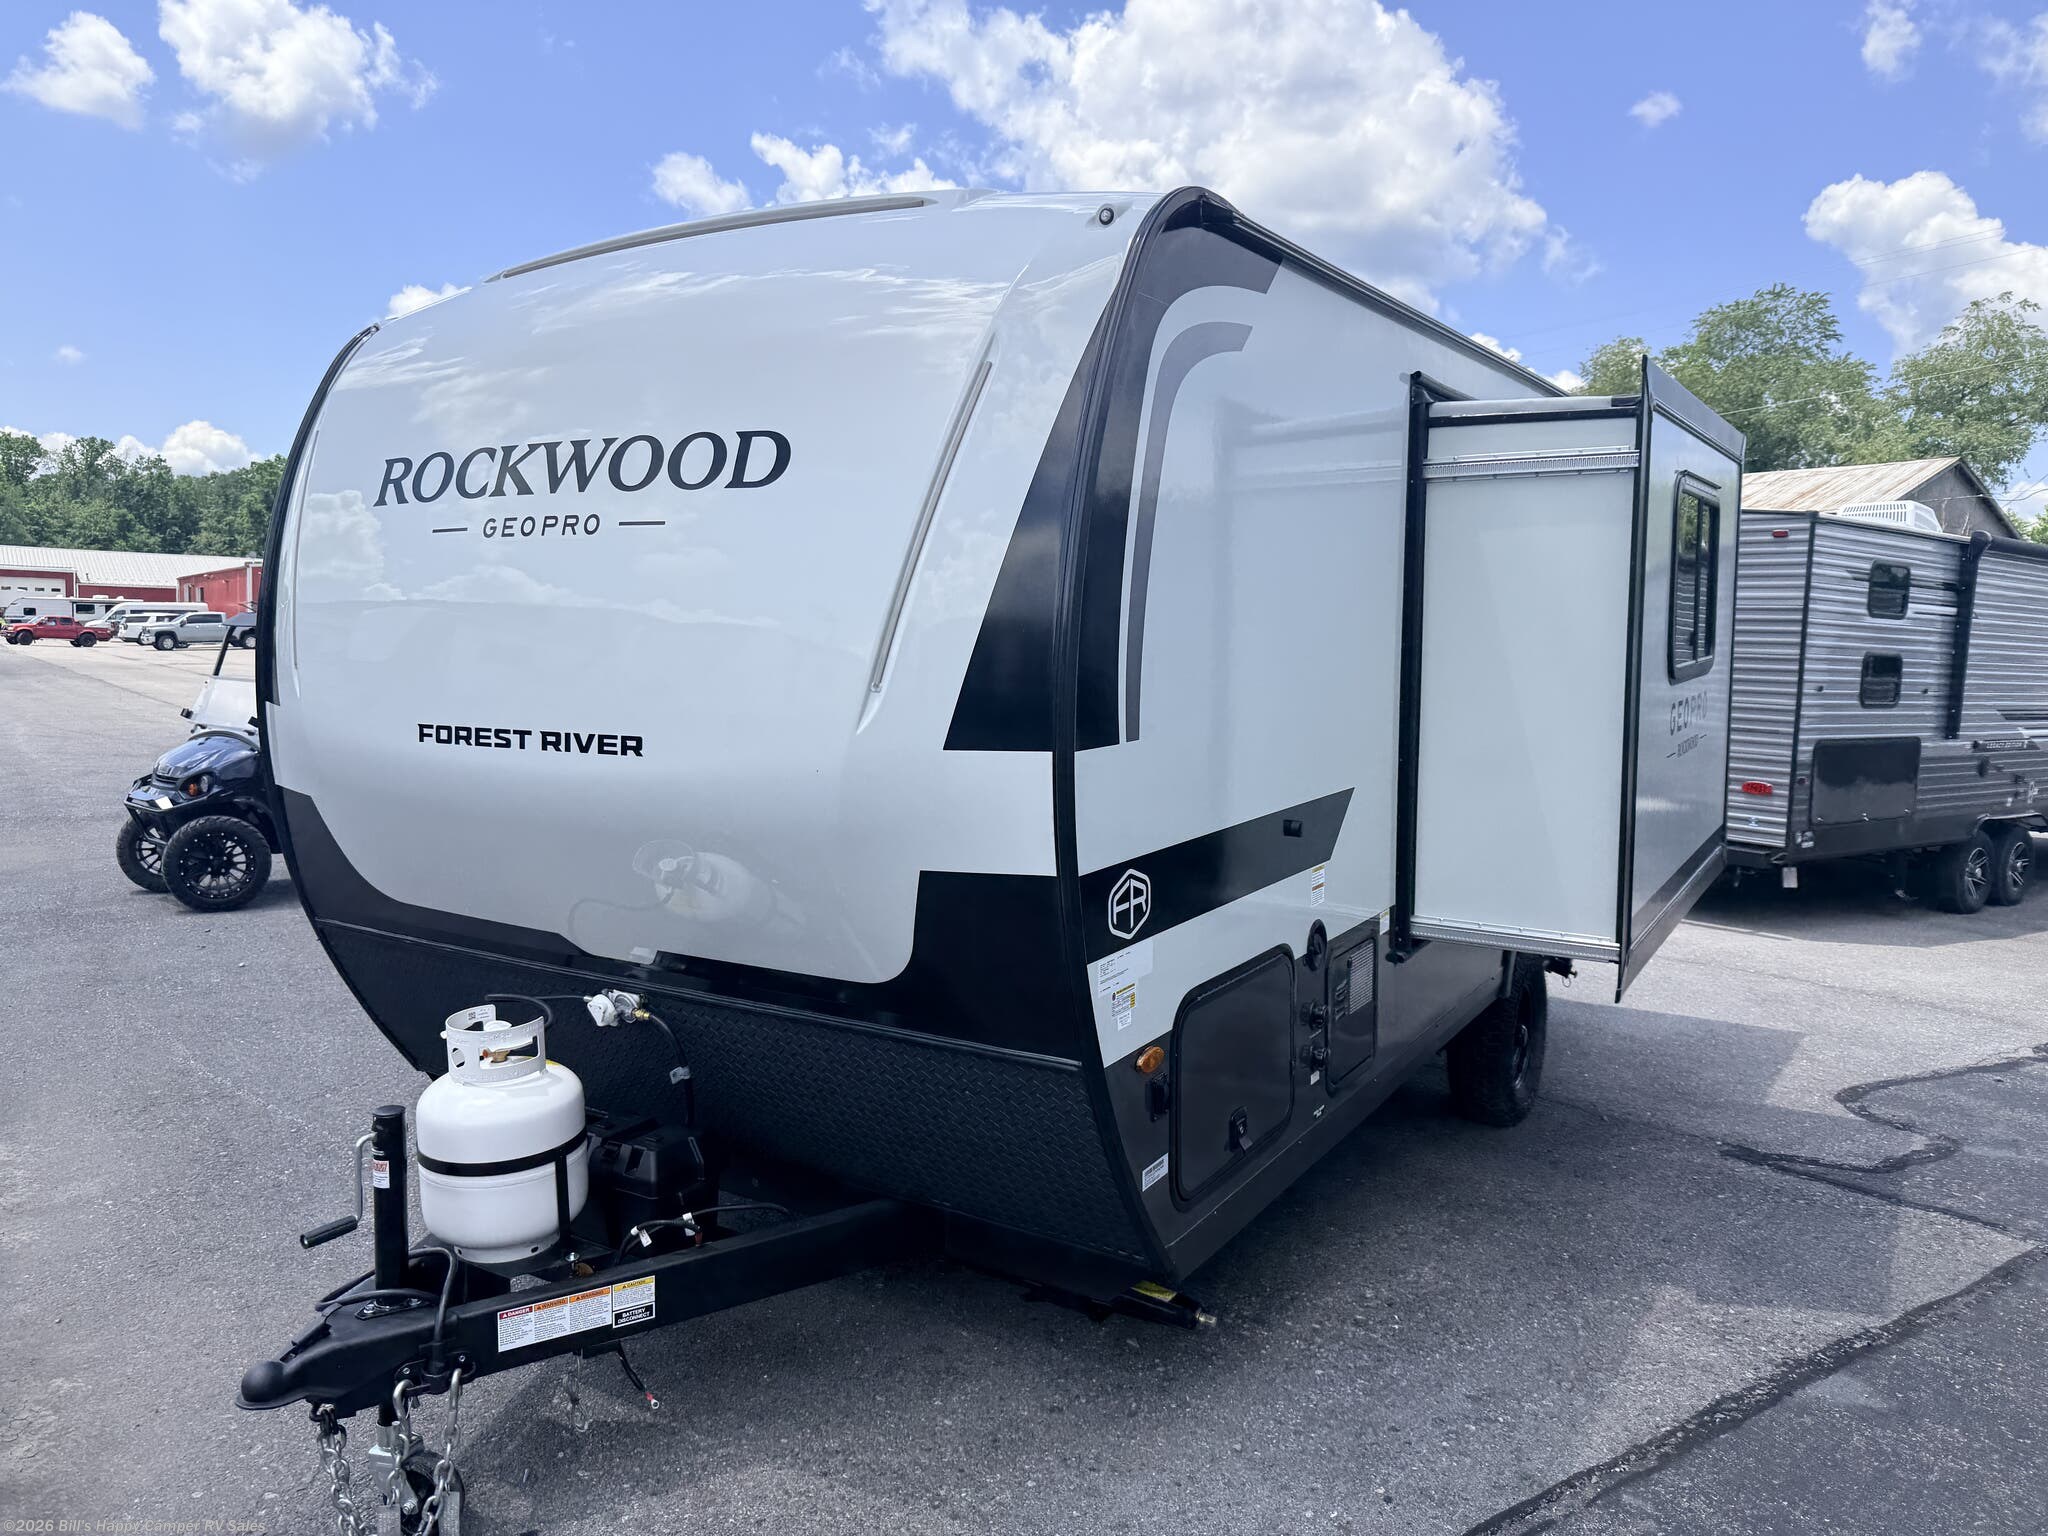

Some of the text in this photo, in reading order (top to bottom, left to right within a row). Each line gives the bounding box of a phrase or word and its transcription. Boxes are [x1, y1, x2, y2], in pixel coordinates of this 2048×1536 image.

[373, 430, 792, 507] ROCKWOOD
[482, 513, 601, 539] GEOPRO
[417, 723, 644, 757] FOREST RIVER
[507, 1307, 531, 1317] DANGER
[617, 1311, 650, 1324] DISCONNECT
[622, 1307, 646, 1318] BATTERY
